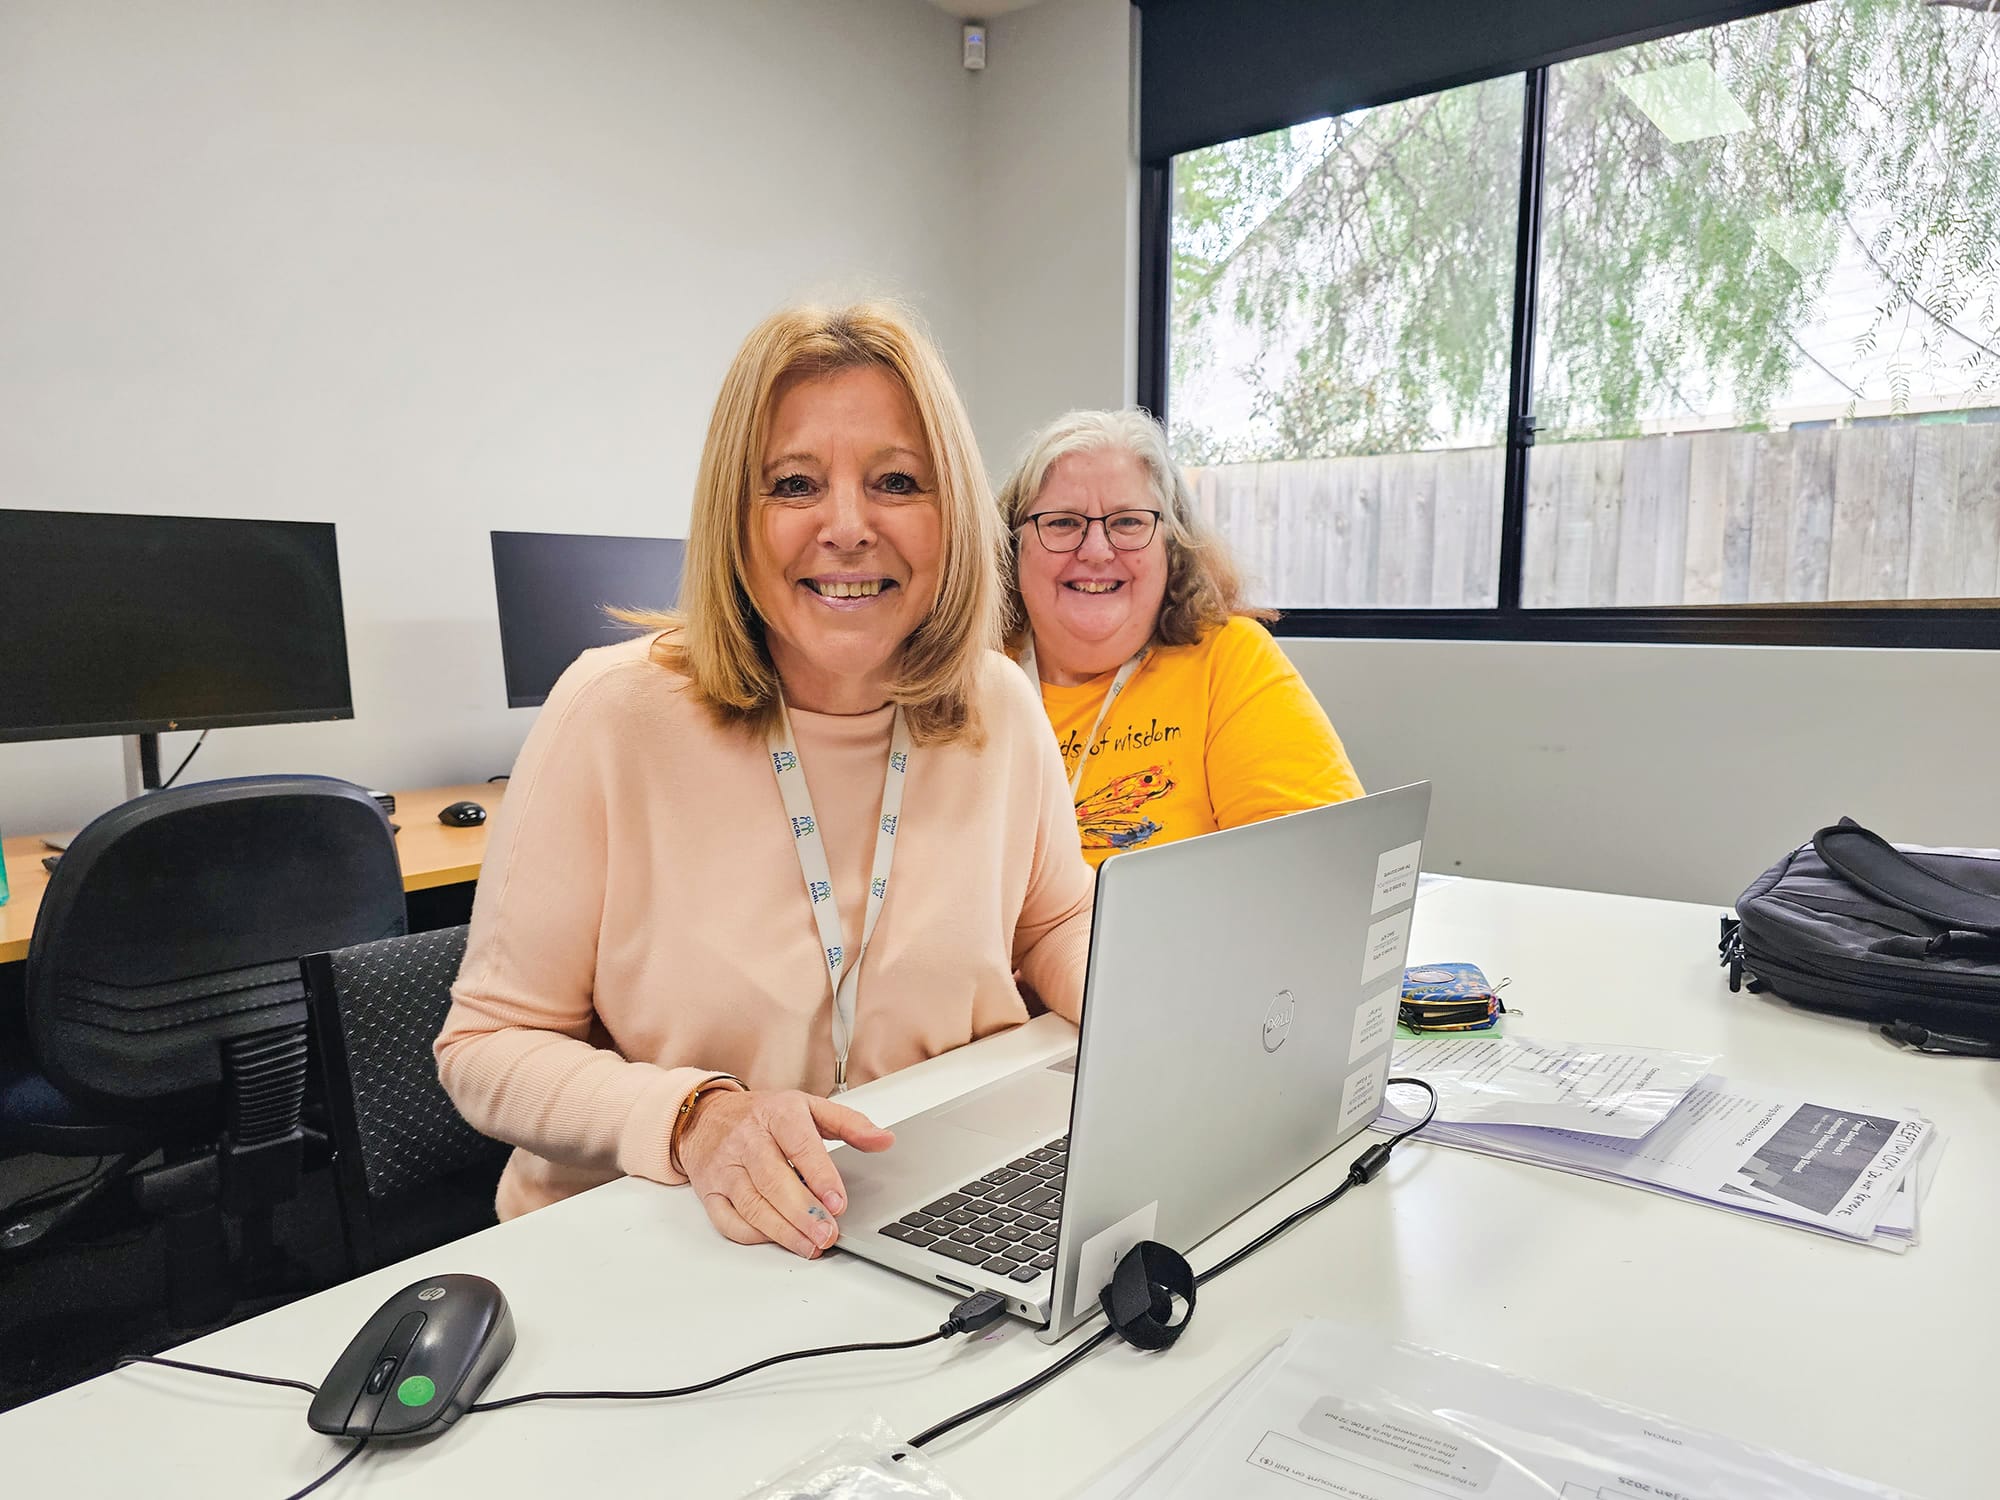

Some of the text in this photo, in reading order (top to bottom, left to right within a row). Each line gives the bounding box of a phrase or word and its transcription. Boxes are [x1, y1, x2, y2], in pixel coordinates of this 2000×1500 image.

[1059, 718, 1182, 760] ds of wisdom
[772, 752, 783, 774] PICAL
[791, 817, 802, 838] PICAL
[890, 815, 898, 835] PICAL
[809, 882, 820, 905] PICAL
[827, 948, 835, 970] PICAL
[1338, 1424, 1372, 1440] balance
[1642, 1429, 1683, 1446] OFFICIAL
[1372, 1436, 1407, 1451] previous
[1259, 1456, 1274, 1466] ($)
[1275, 1462, 1290, 1472] bill
[1292, 1469, 1305, 1478] on
[1307, 1475, 1347, 1492] amount
[1617, 1476, 1651, 1492] 2025
